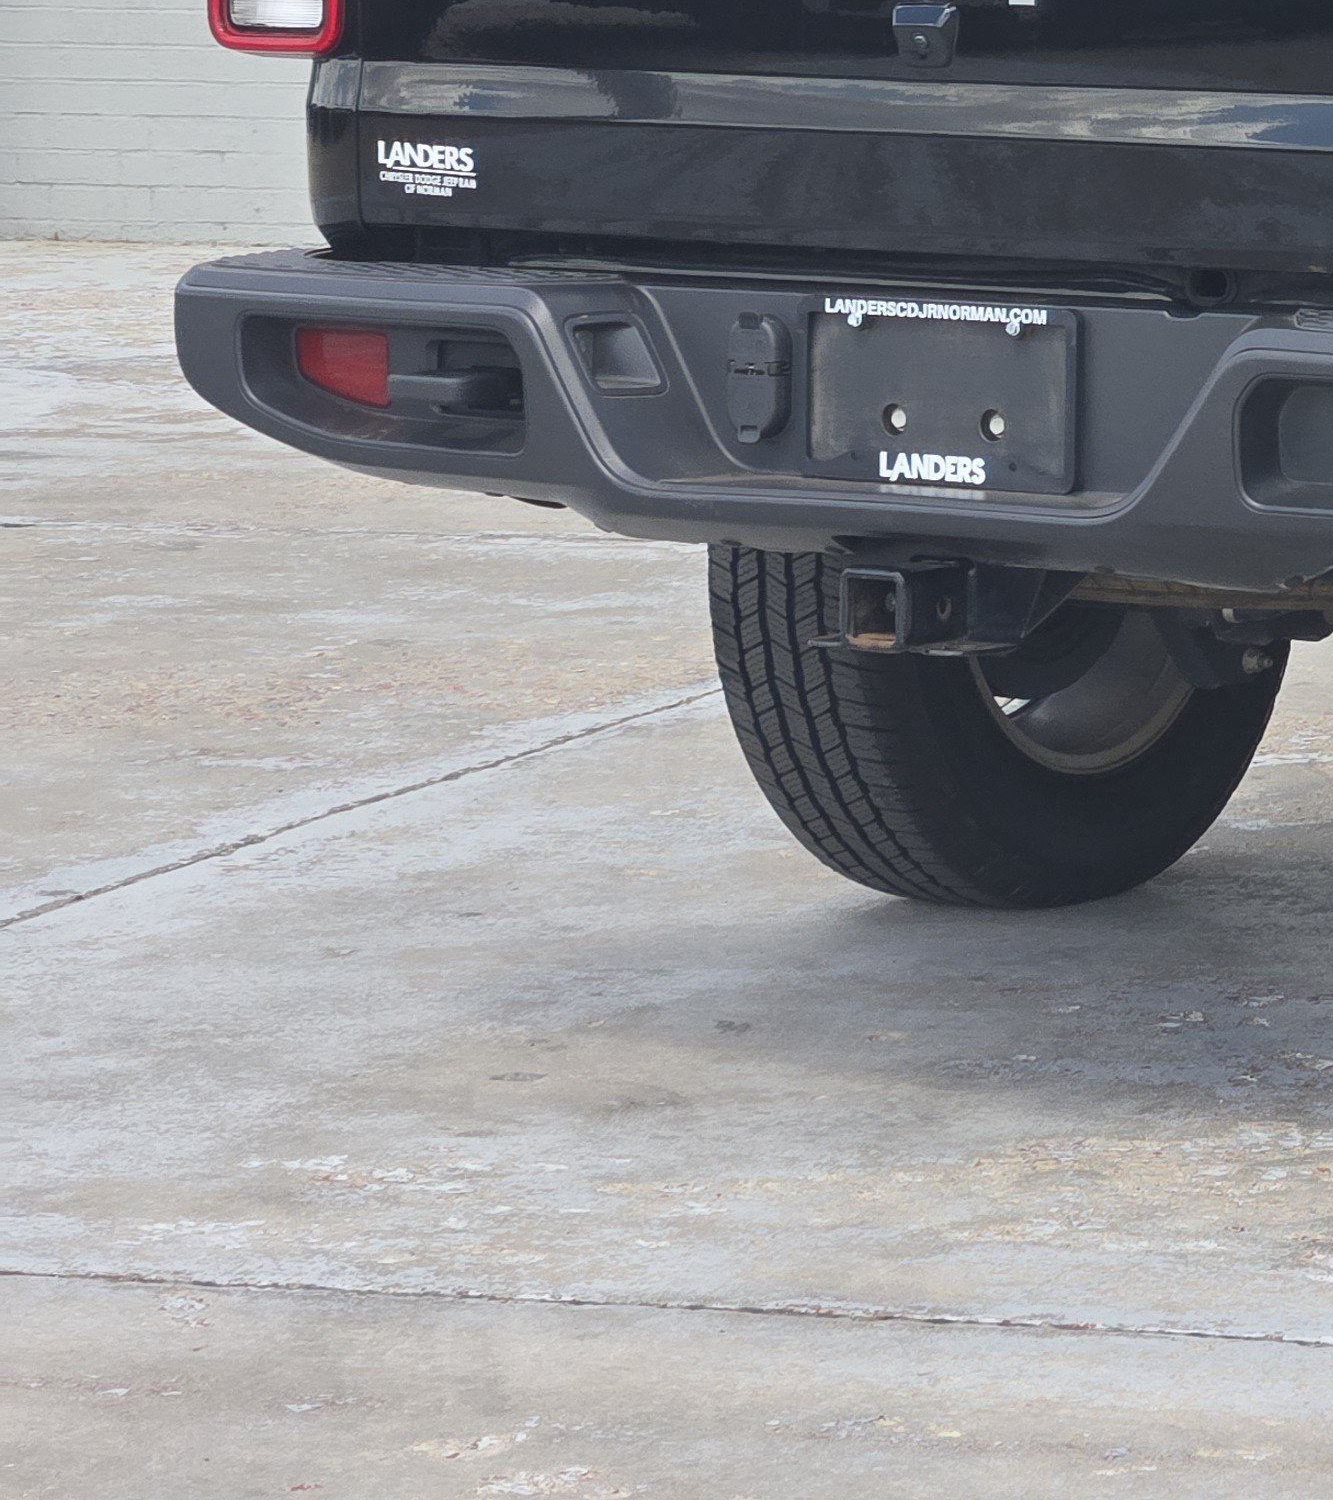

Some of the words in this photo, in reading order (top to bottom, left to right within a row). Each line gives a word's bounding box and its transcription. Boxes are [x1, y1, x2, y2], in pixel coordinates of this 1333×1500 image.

[377, 139, 475, 172] LANDERS
[824, 297, 1048, 326] LANDERSCDJRNORMAN.COM
[878, 450, 986, 485] LANDERS
